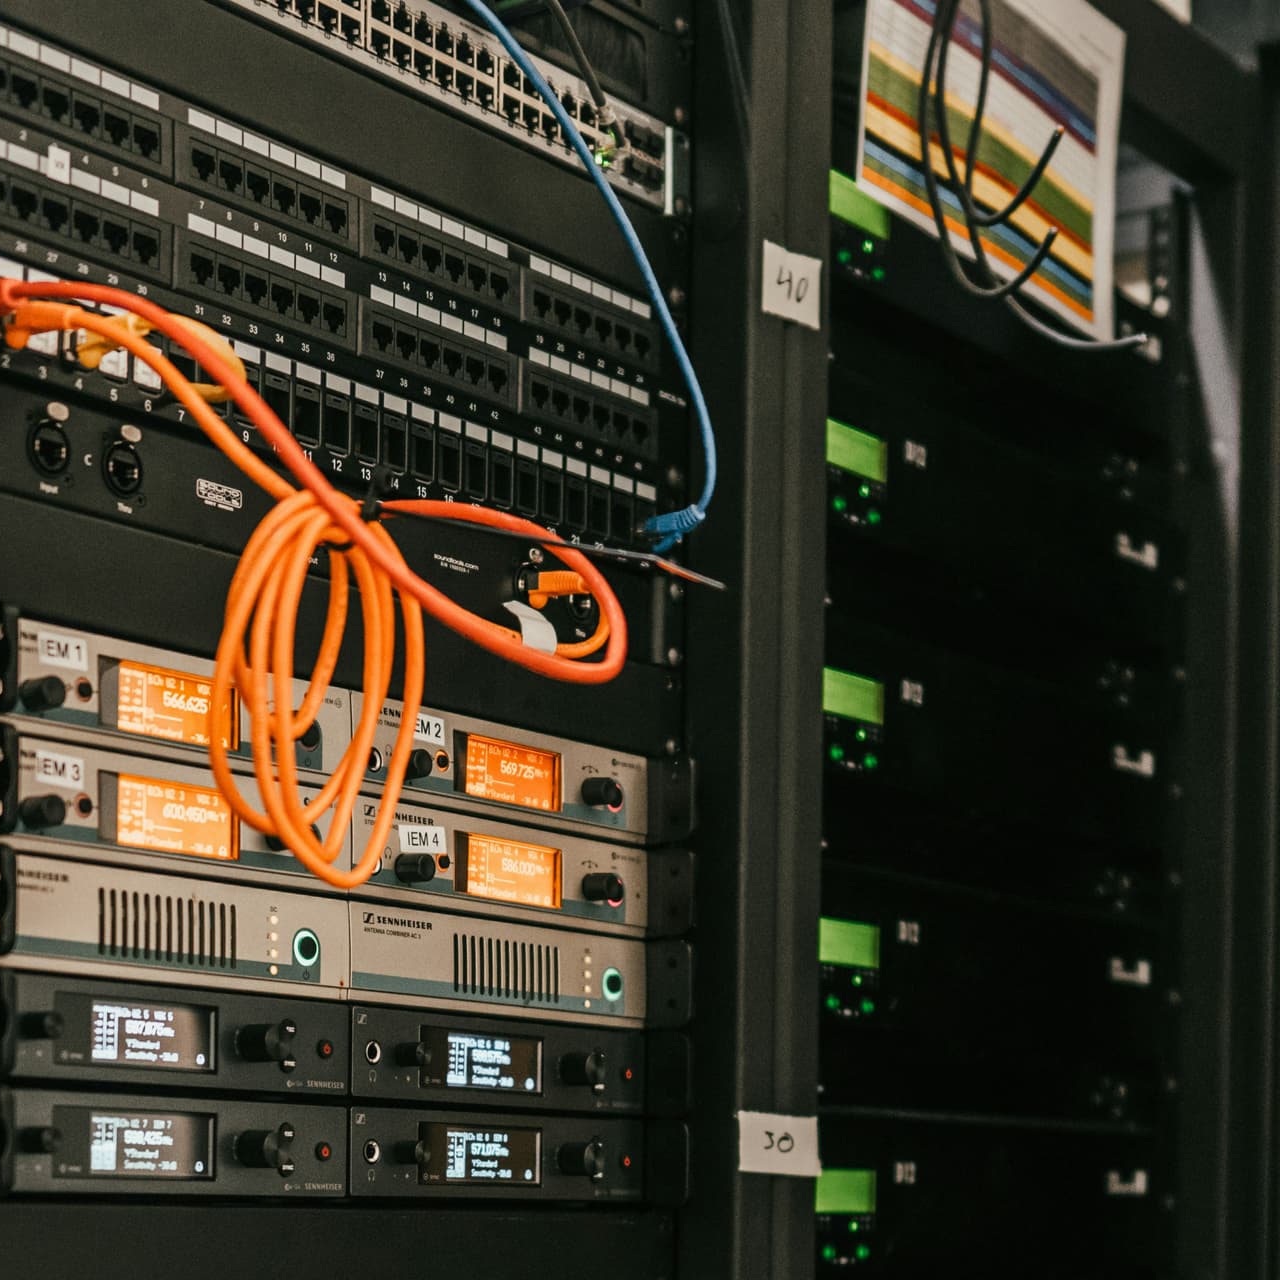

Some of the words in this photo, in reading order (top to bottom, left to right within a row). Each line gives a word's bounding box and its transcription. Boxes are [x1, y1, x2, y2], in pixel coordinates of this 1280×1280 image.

[199, 200, 205, 209] 7
[226, 211, 232, 221] 8
[253, 222, 259, 231] 9
[278, 232, 287, 243] 10
[304, 242, 312, 252] 11
[329, 252, 338, 263] 12
[378, 271, 387, 282] 13
[401, 281, 410, 291] 14
[425, 290, 434, 300] 15
[448, 300, 456, 310] 16
[470, 308, 478, 318] 17
[776, 265, 809, 304] 40
[137, 285, 147, 295] 30
[194, 304, 204, 315] 31
[222, 314, 231, 325] 32
[248, 323, 258, 334] 33
[275, 333, 284, 343] 34
[301, 343, 310, 353] 35
[326, 351, 336, 362] 36
[376, 369, 384, 379] 37
[400, 377, 408, 387] 38
[423, 386, 432, 396] 39
[446, 394, 455, 404] 40
[469, 402, 477, 412] 41
[491, 409, 499, 419] 42
[1, 354, 10, 368] 2
[38, 365, 47, 379] 3
[74, 377, 83, 390] 4
[109, 388, 118, 402] 5
[144, 399, 152, 412] 6
[177, 409, 185, 422] 7
[242, 430, 249, 442] 9
[332, 458, 342, 472] 12
[360, 467, 371, 481] 13
[416, 485, 427, 499] 15
[570, 535, 581, 546] 21
[84, 454, 93, 466] C
[76, 644, 82, 662] 1
[414, 717, 430, 736] EM
[434, 722, 441, 738] 2
[72, 764, 80, 781] 3
[395, 812, 434, 826] NHEISER
[407, 831, 429, 847] IEM
[432, 833, 439, 847] 4
[376, 915, 433, 931] SENNHEISER
[363, 926, 385, 935] ANTENNA
[386, 928, 410, 939] COMBINER
[307, 1079, 344, 1090] SENNHEISER
[763, 1129, 794, 1153] 30
[304, 1182, 342, 1192] SENNHEISER
